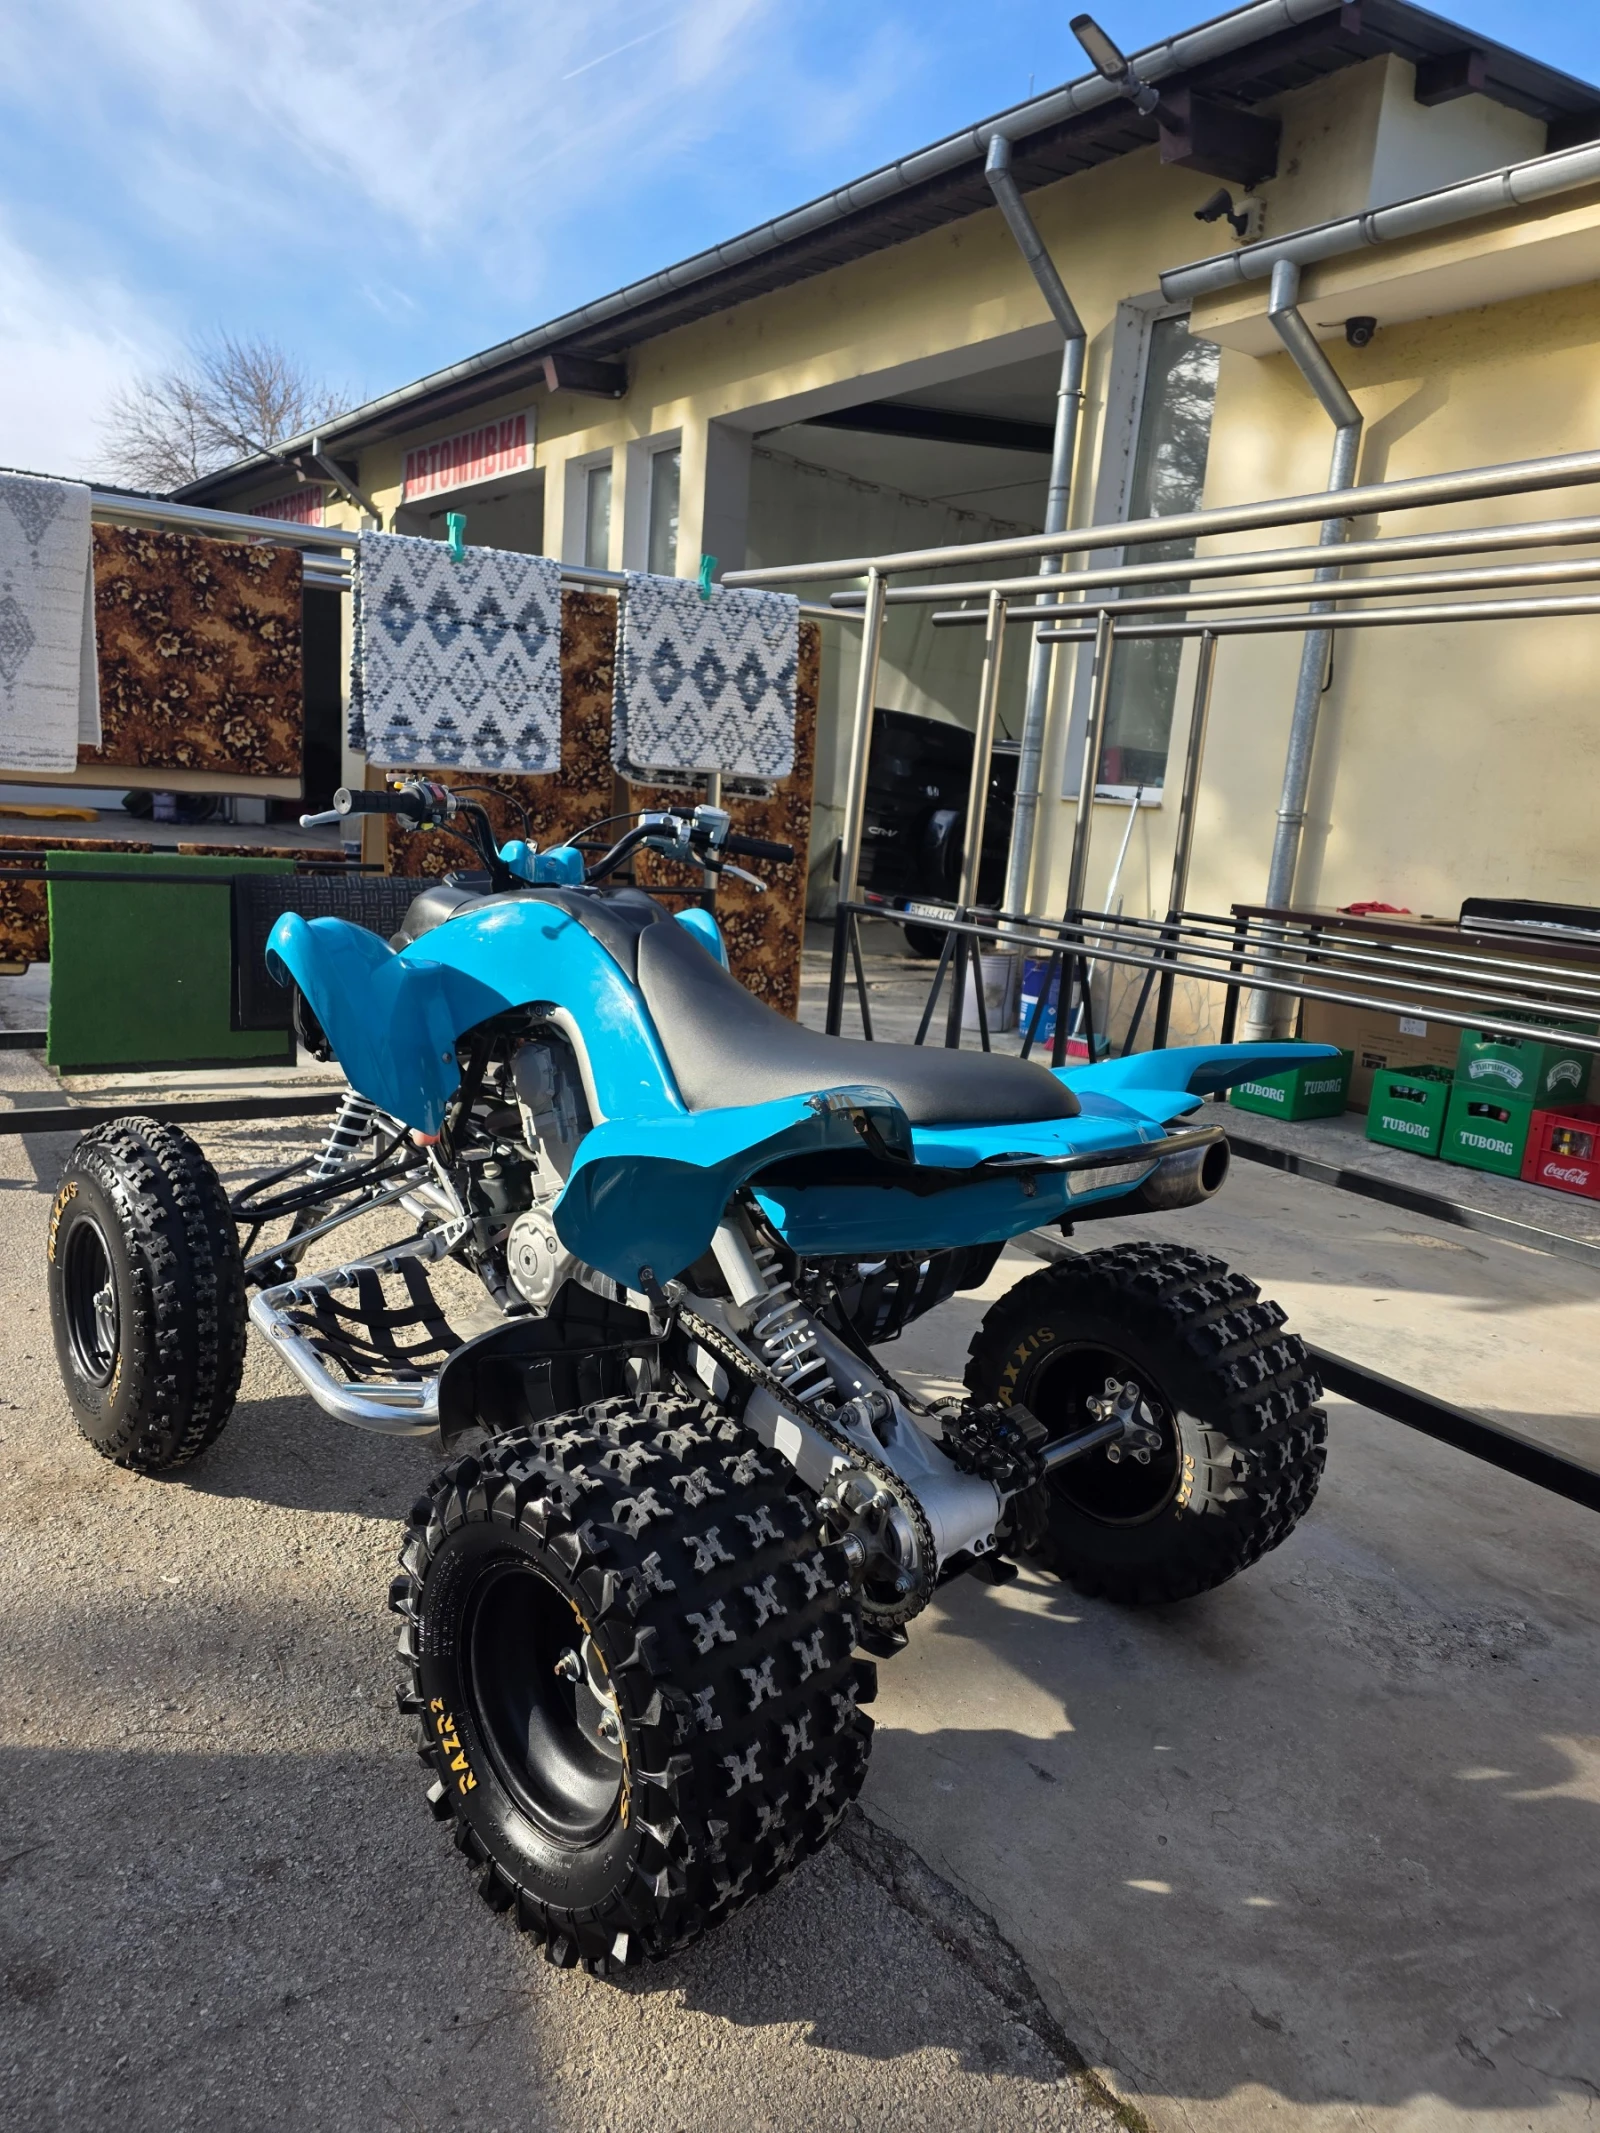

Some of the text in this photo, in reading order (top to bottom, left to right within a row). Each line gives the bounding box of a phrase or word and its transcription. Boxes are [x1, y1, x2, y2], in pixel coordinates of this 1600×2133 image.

[406, 414, 526, 498] АВТОМИВКА
[1240, 1082, 1285, 1102] TUBORG
[1304, 1079, 1341, 1095] TUBORG
[1382, 1116, 1430, 1138] TUBORG
[1460, 1131, 1513, 1155] TUBORG
[999, 1327, 1055, 1407] AXXIS
